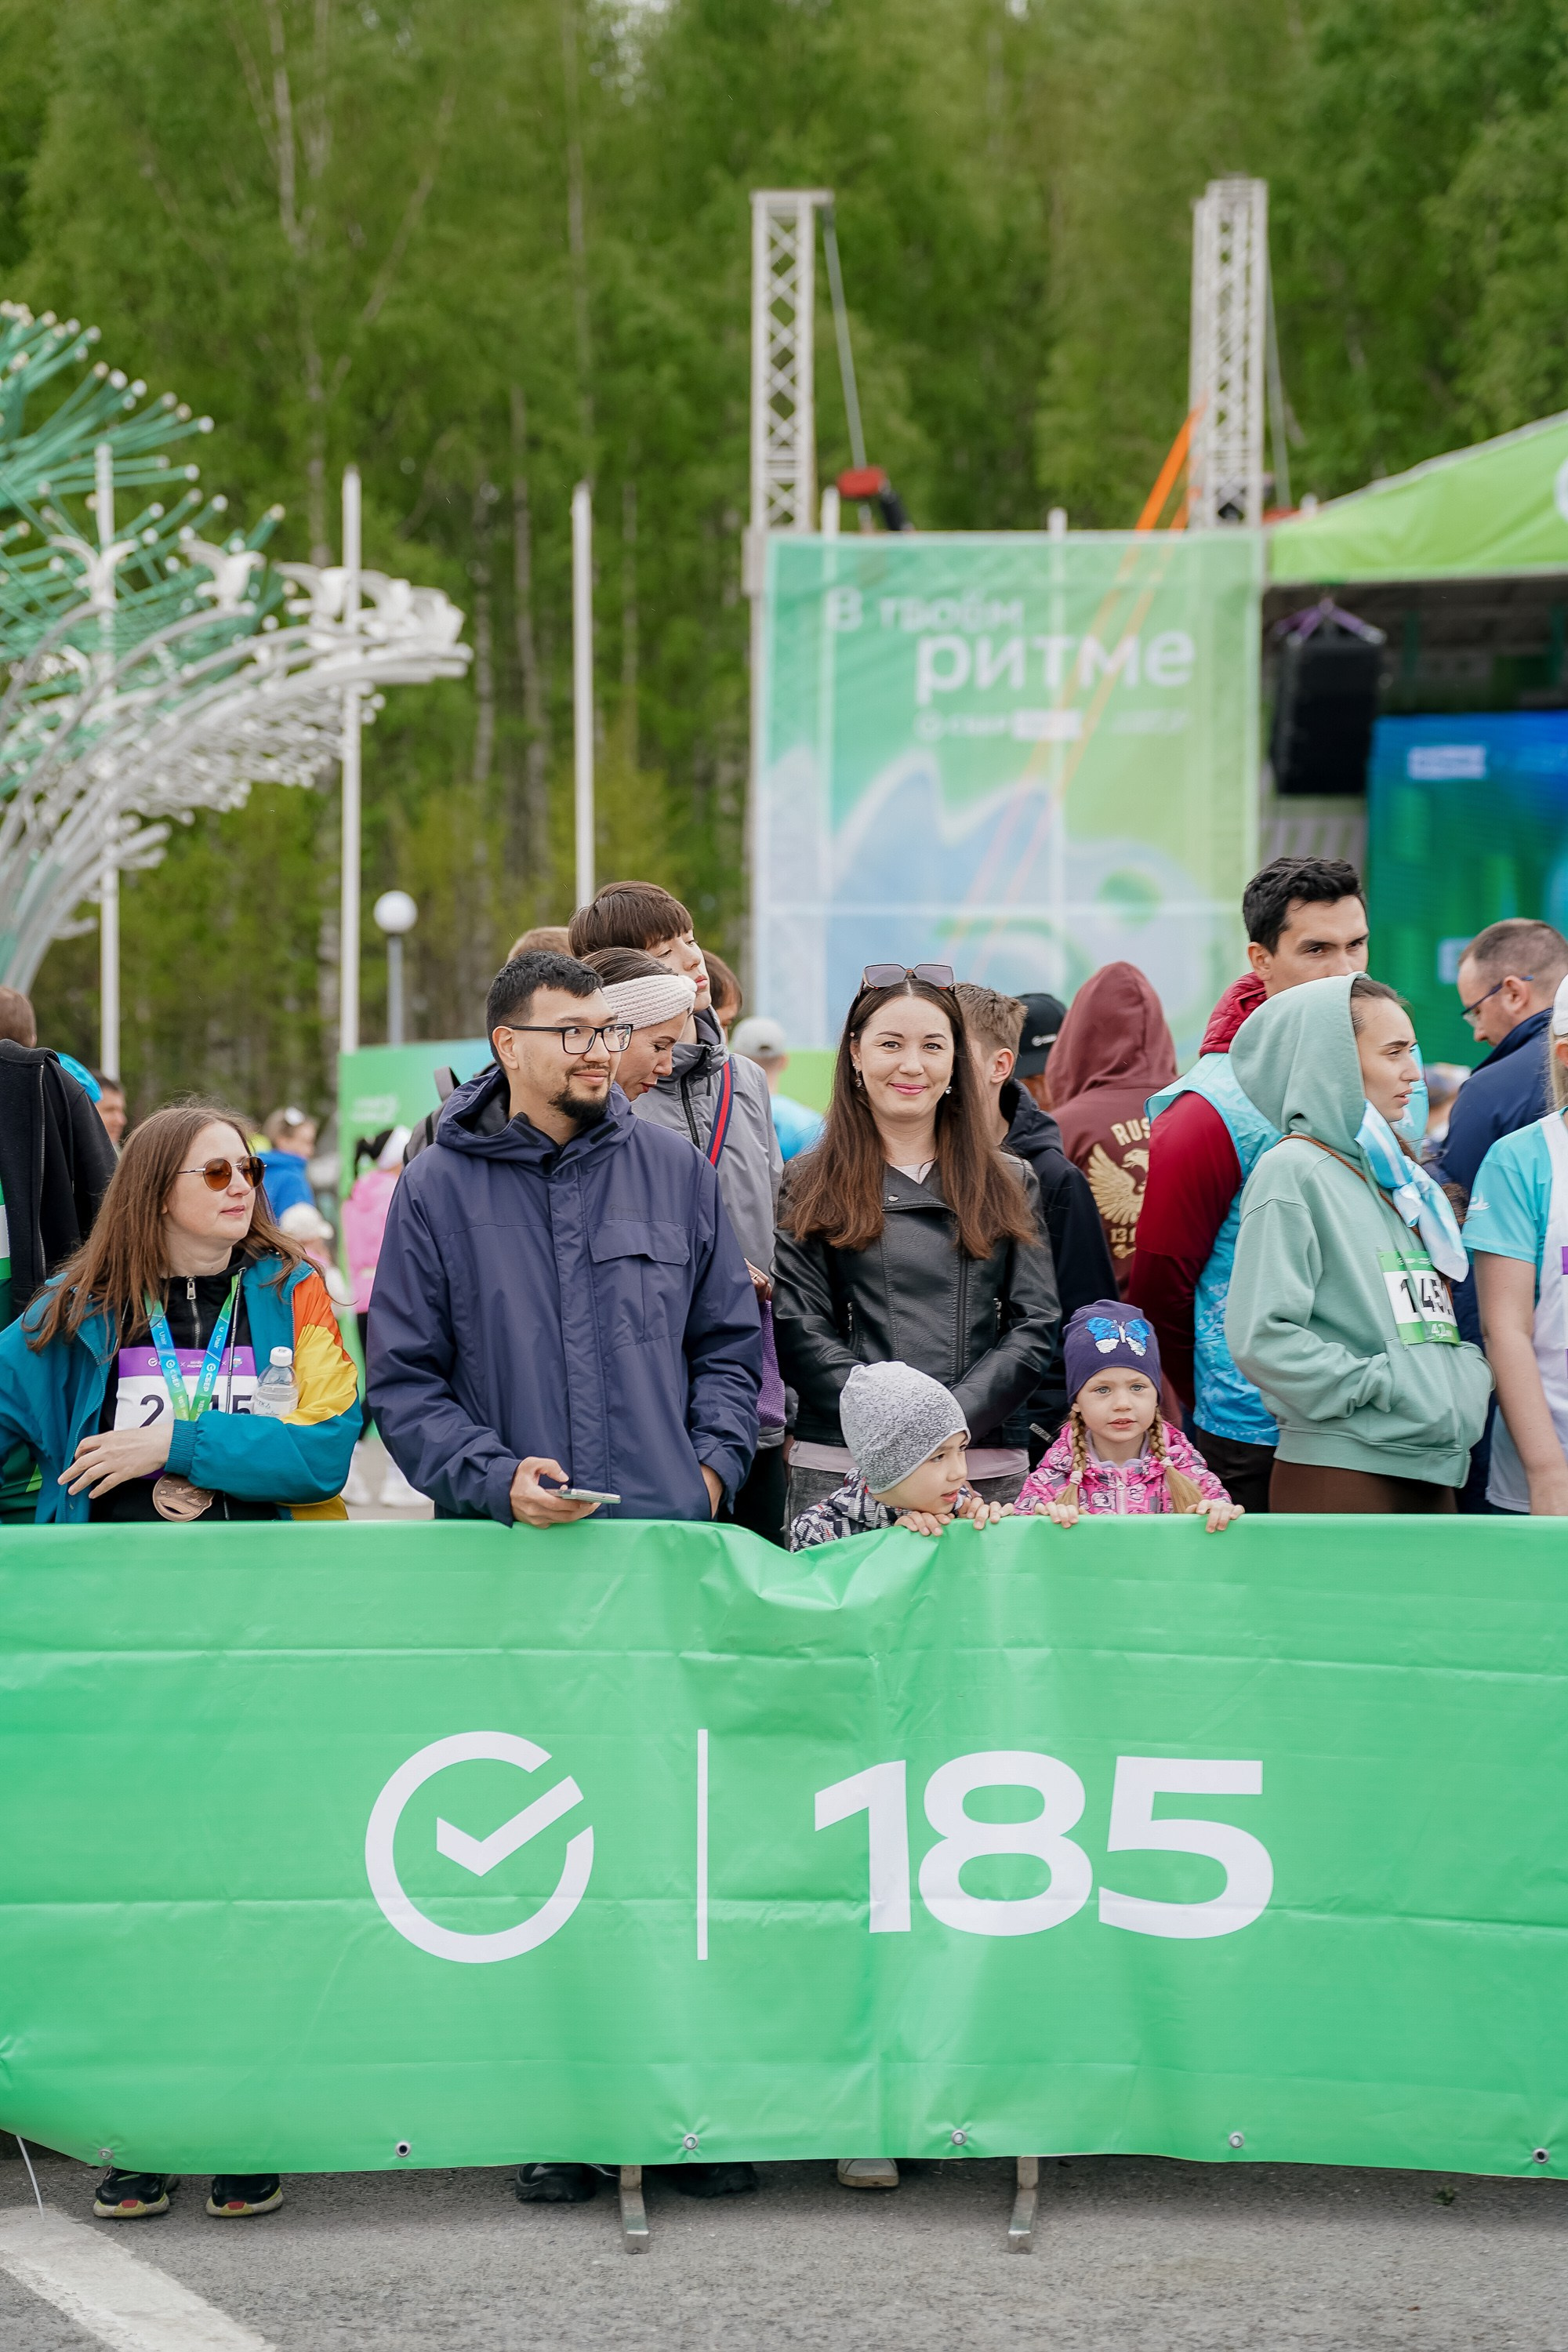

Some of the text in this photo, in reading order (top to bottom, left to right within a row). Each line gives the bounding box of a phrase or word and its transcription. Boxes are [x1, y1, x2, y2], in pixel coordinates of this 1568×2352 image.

[828, 588, 863, 631] В
[915, 630, 1196, 704] ритме
[204, 1372, 212, 1392] СБЕР
[815, 1750, 1274, 1940] 185
